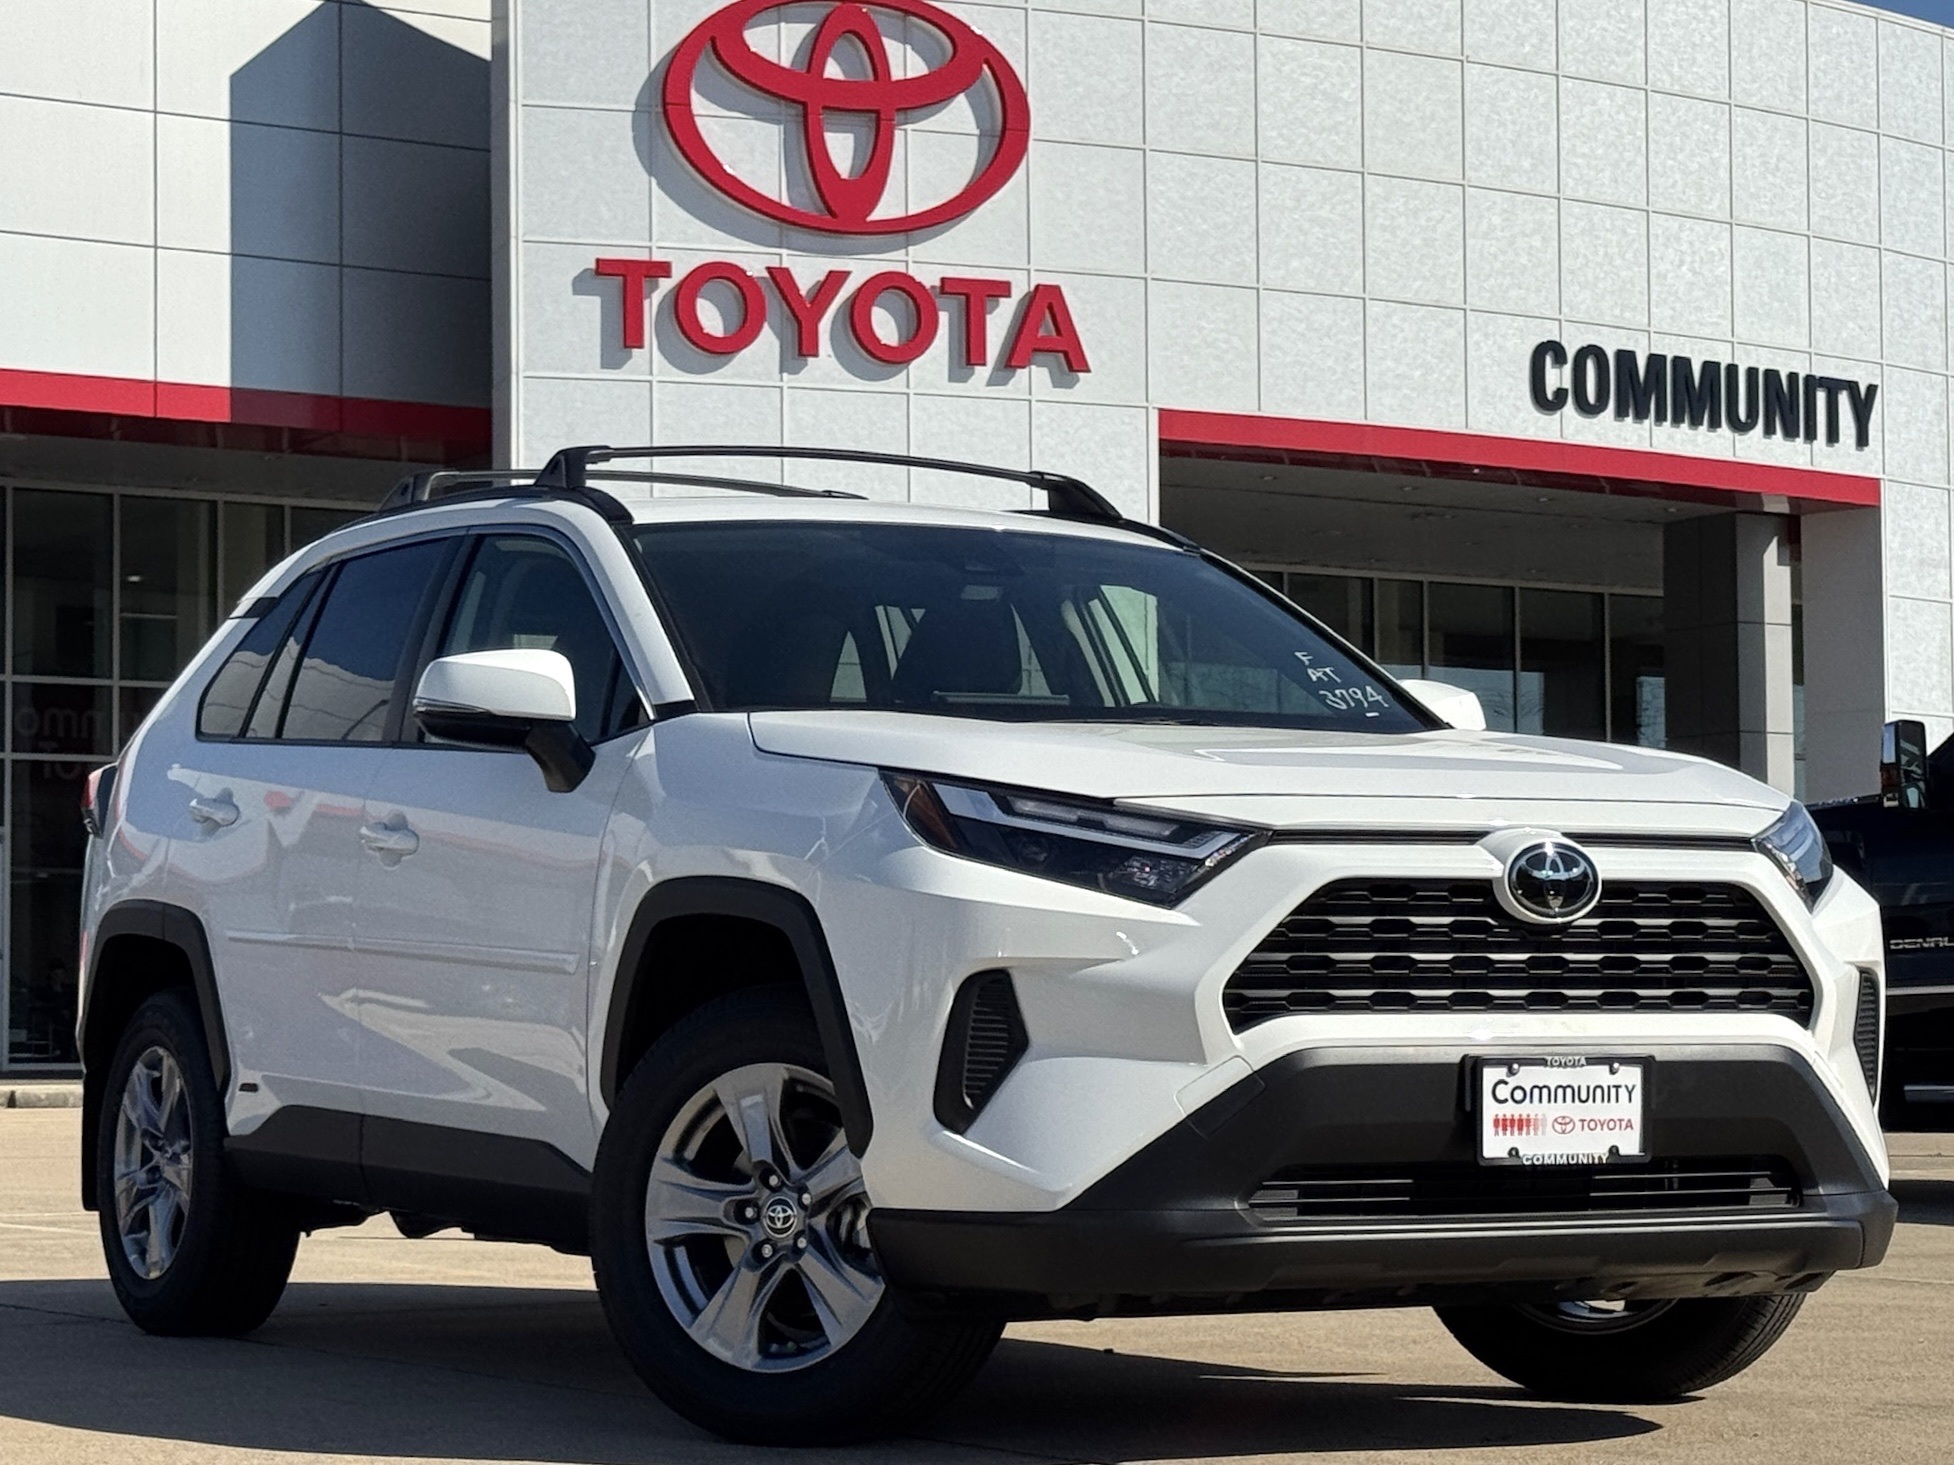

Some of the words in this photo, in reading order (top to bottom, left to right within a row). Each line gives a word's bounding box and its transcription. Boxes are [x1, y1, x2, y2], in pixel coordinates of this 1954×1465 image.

[595, 258, 1091, 373] TOYOTA
[1530, 340, 1879, 448] COMMUNITY
[1545, 1055, 1587, 1067] TOYOTA
[1578, 1118, 1634, 1132] TOYOTA
[1522, 1152, 1609, 1166] COMMUNITY
